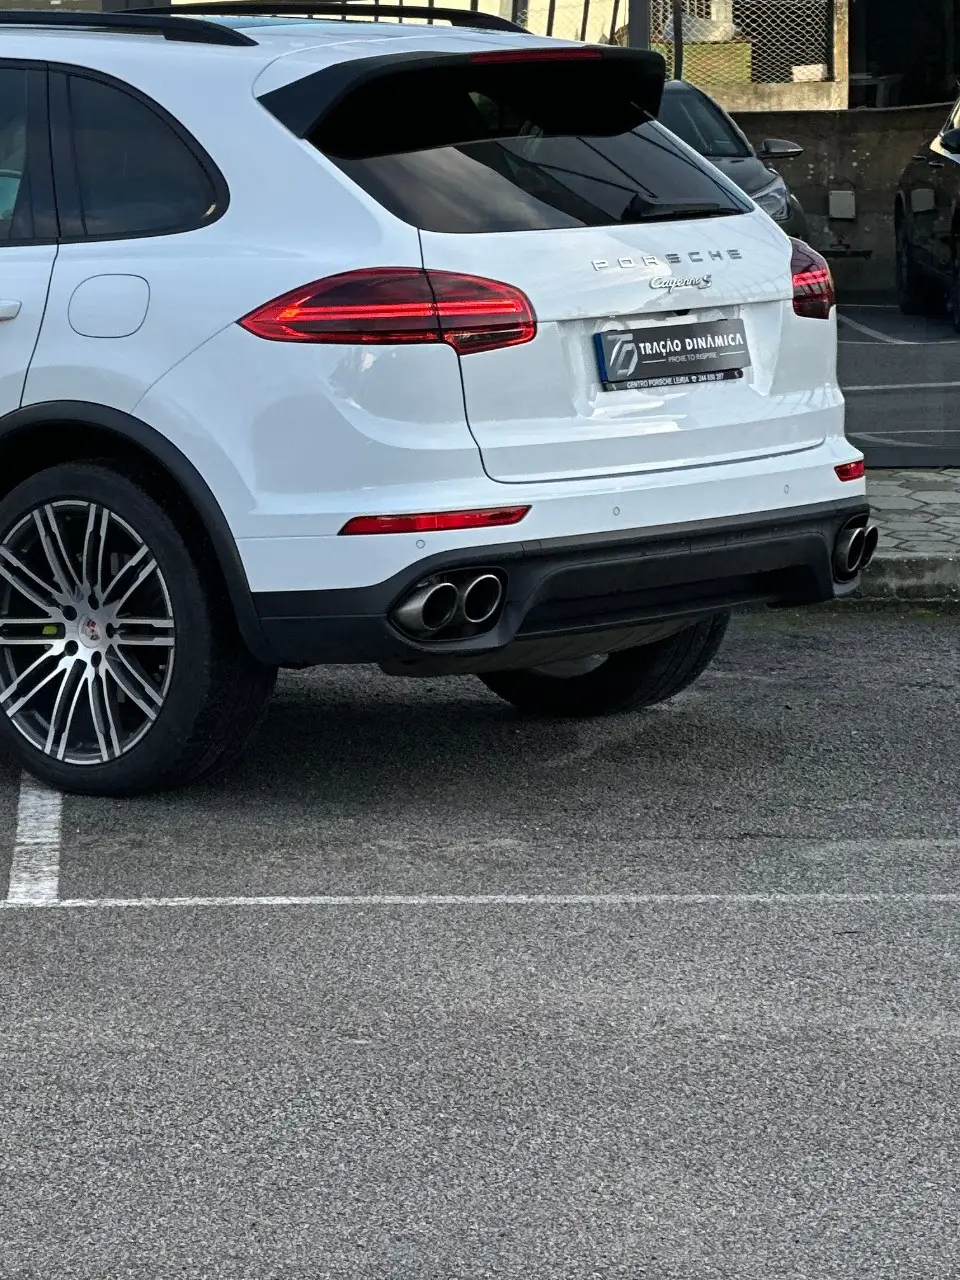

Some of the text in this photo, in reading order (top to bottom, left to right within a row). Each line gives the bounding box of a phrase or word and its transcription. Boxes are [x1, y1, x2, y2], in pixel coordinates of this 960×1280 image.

[591, 249, 743, 271] PORSCHE
[649, 276, 701, 294] Cayenne
[685, 333, 744, 350] DINÂMICA
